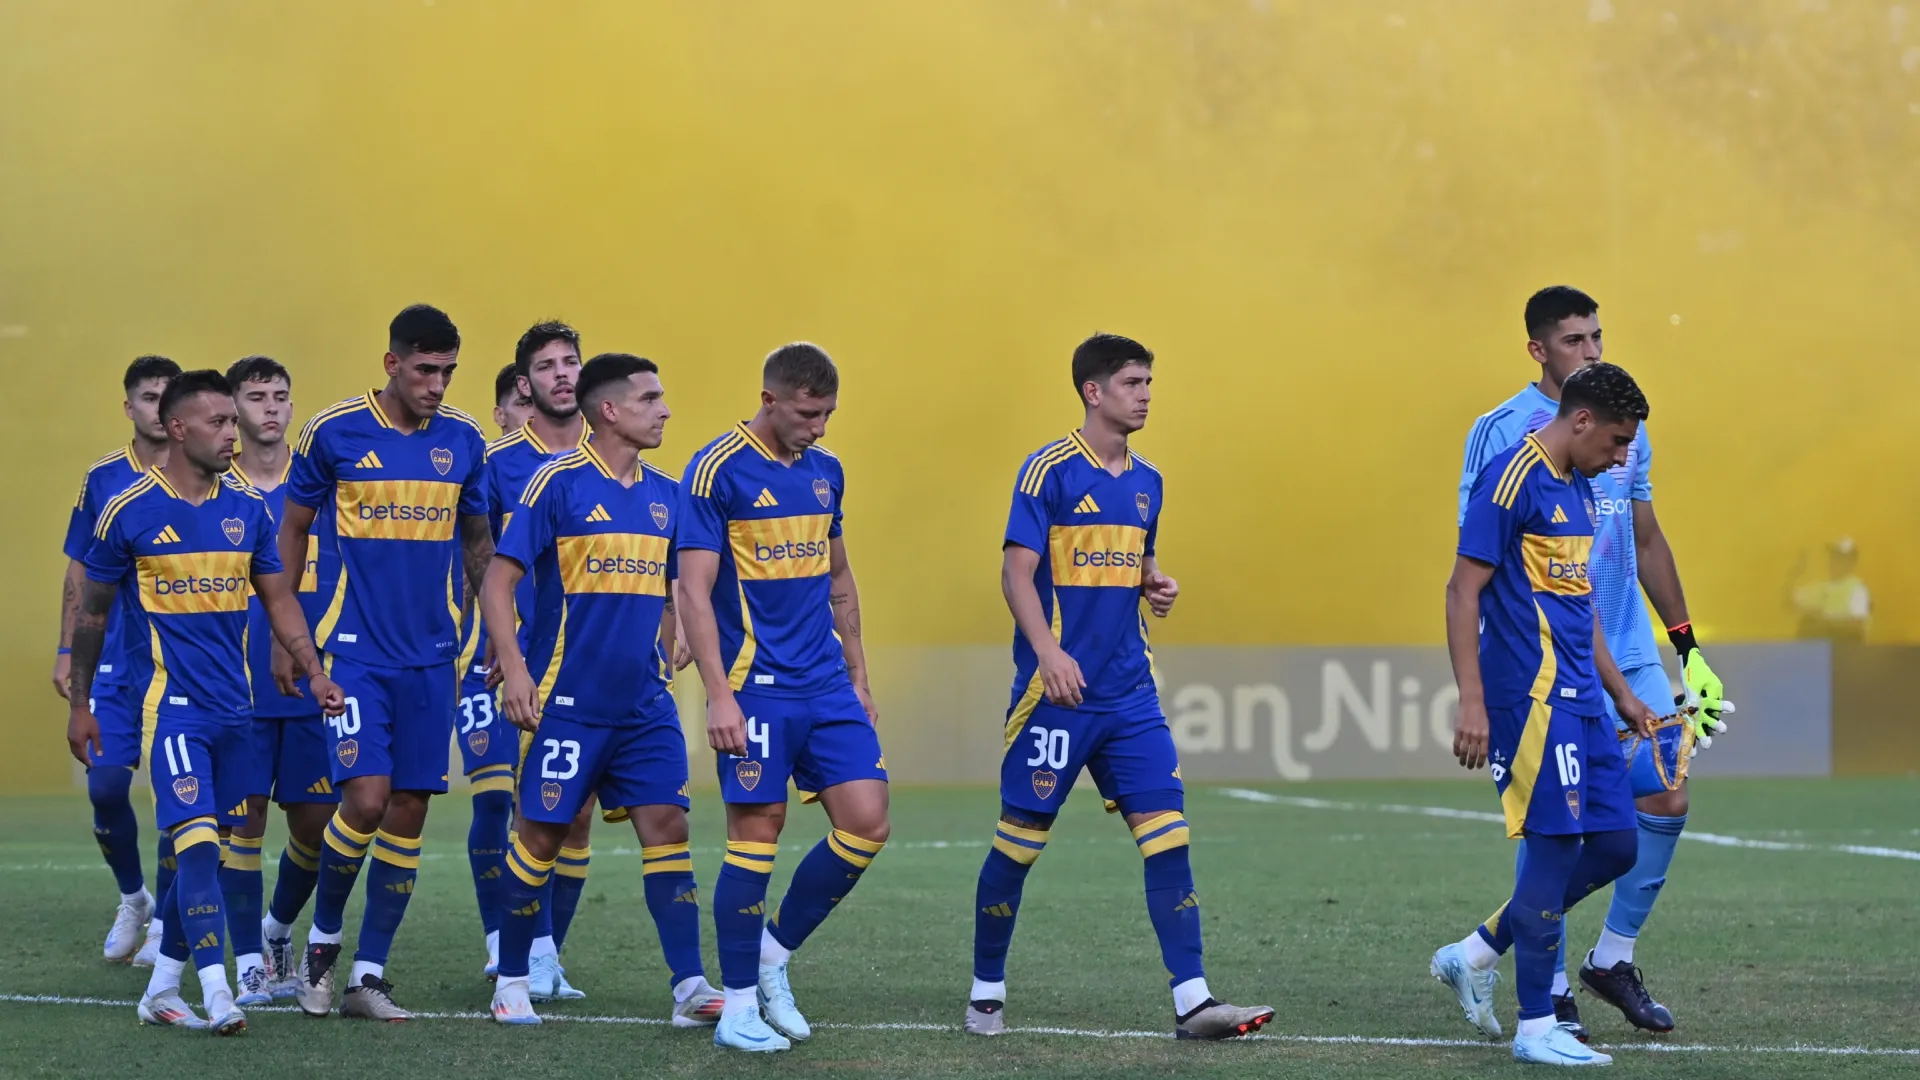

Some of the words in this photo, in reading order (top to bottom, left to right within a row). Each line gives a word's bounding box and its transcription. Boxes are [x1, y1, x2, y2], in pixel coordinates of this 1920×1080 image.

[359, 501, 450, 522] betsson
[755, 540, 828, 561] betsso
[155, 575, 246, 595] betsson
[458, 693, 493, 734] 33
[1156, 668, 1311, 781] an
[164, 733, 193, 776] 11
[729, 716, 769, 759] 4
[1027, 726, 1070, 770] 30
[541, 738, 581, 780] 23
[1555, 743, 1580, 787] 16
[177, 784, 196, 794] CABJ
[1034, 779, 1054, 787] CABJ
[187, 904, 219, 916] CABJ
